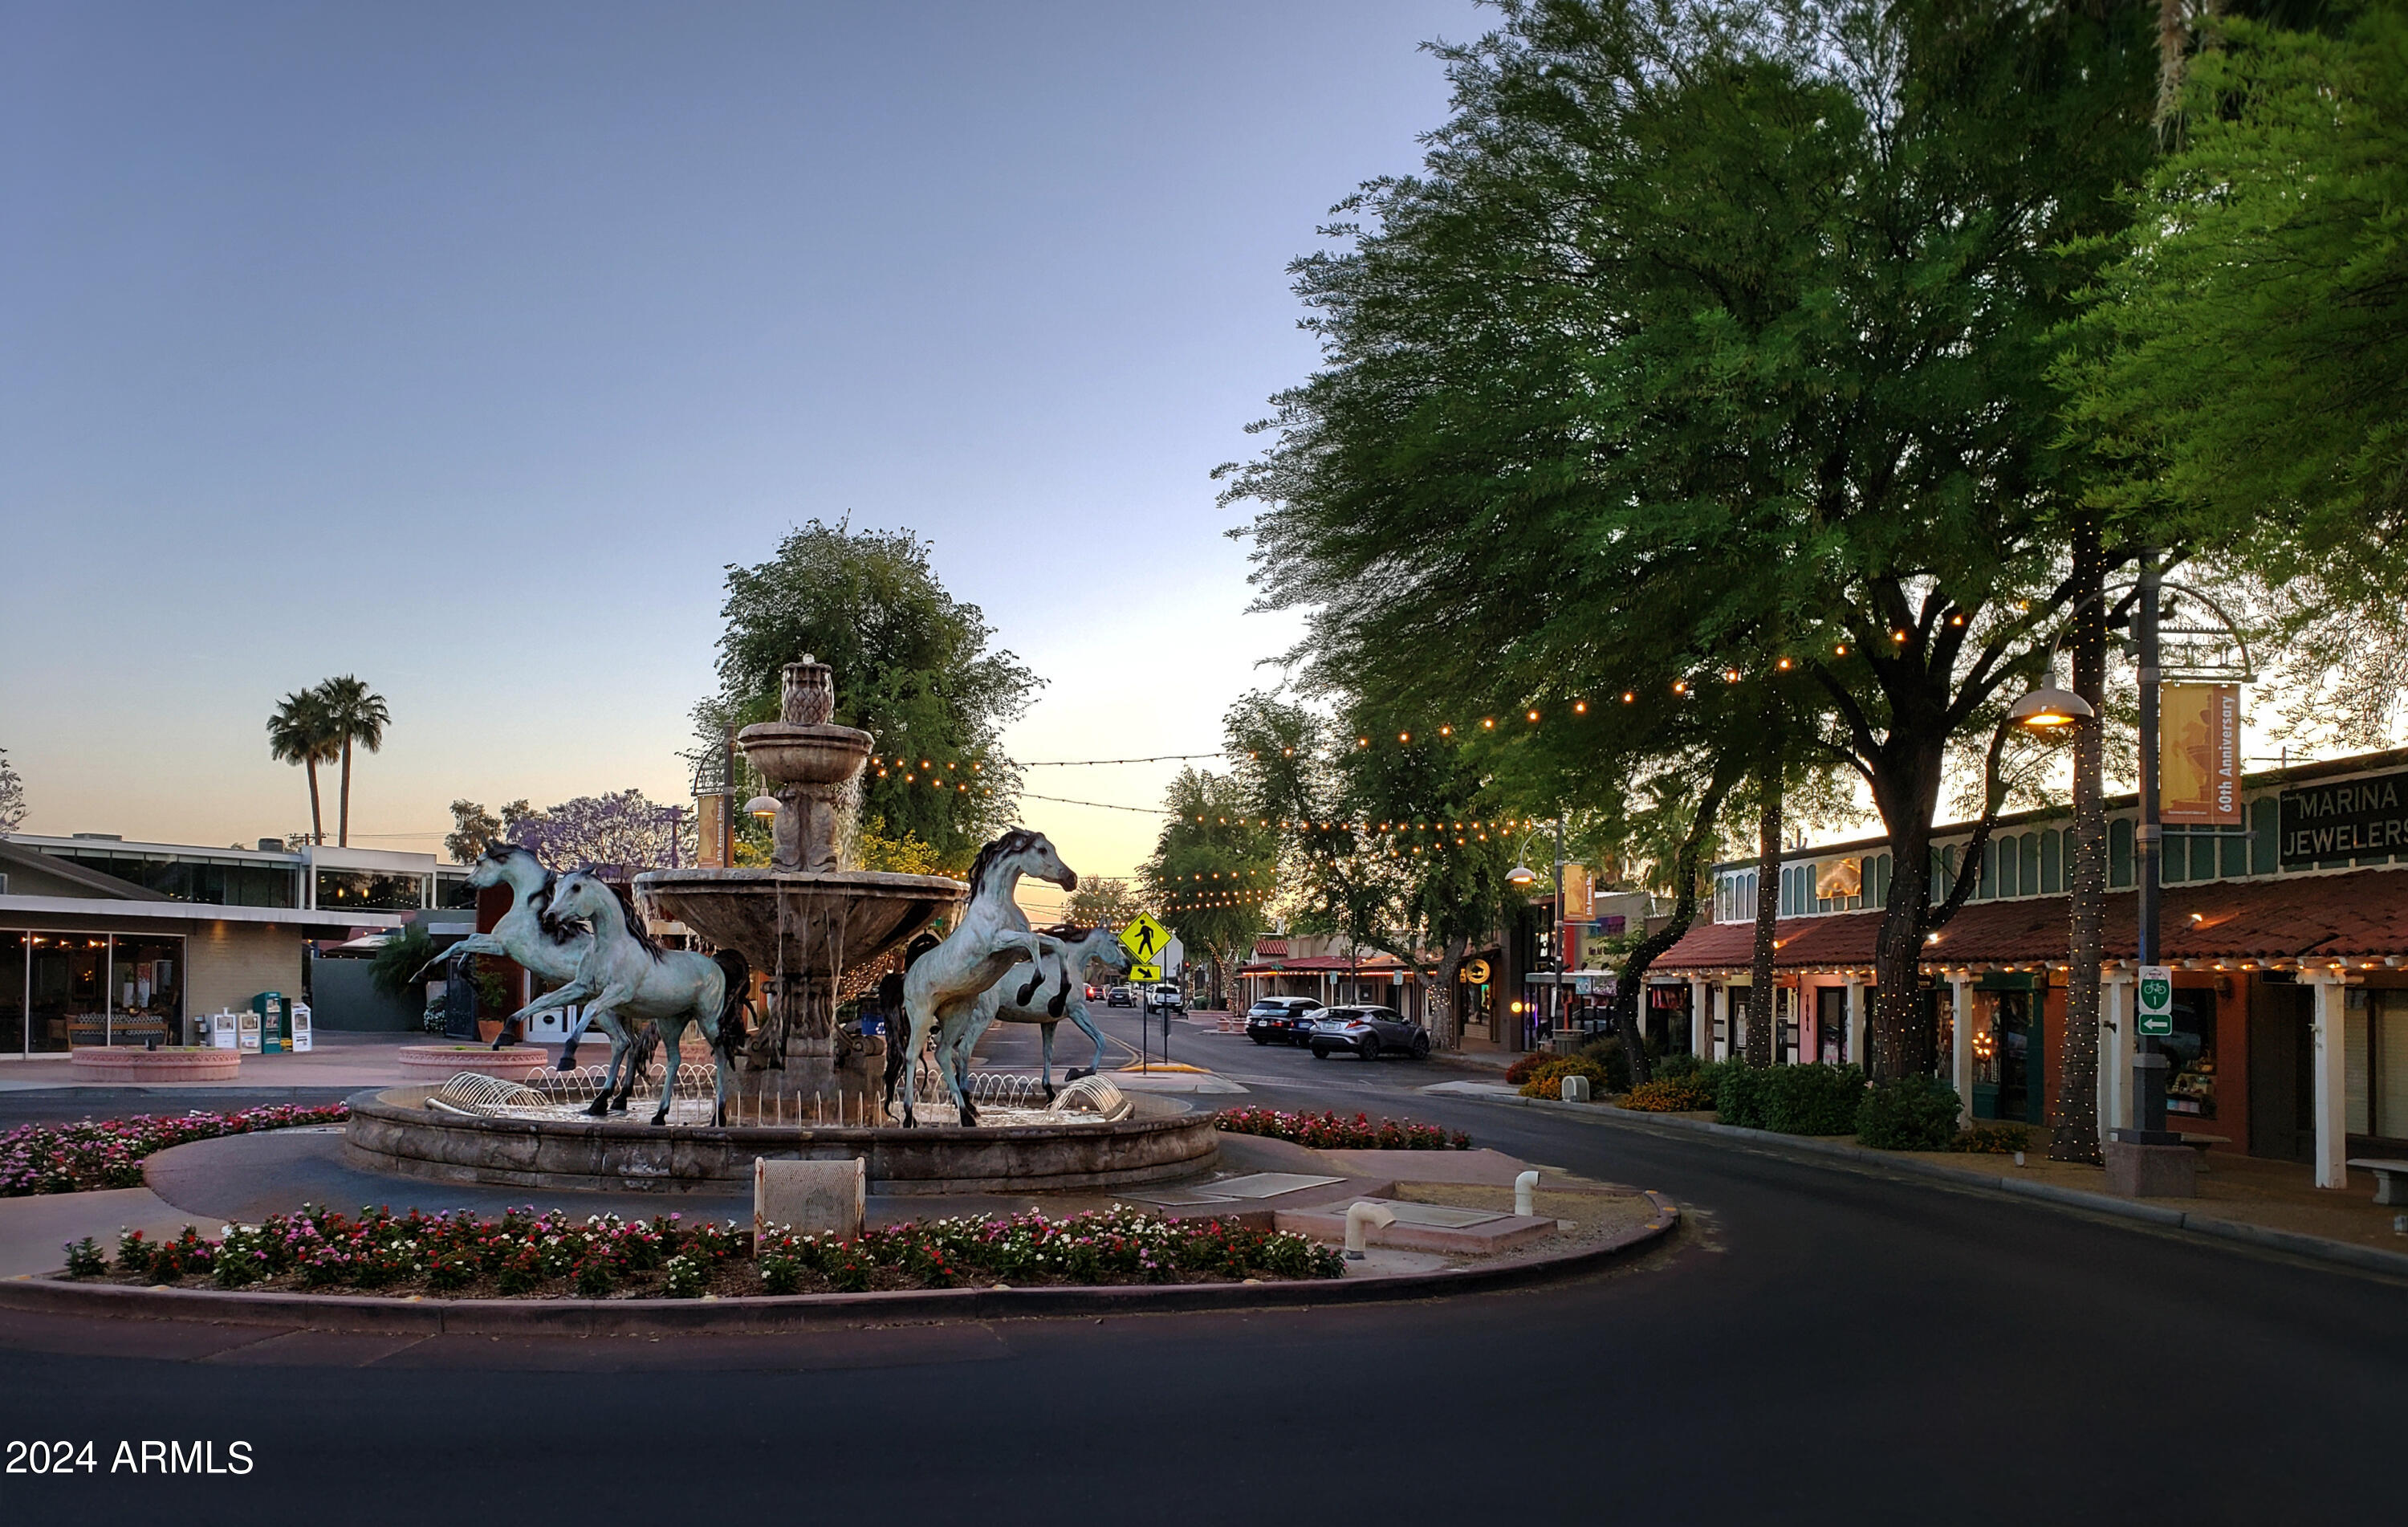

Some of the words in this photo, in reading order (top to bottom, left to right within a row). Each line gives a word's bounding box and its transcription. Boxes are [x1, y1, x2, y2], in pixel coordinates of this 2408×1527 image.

[2218, 696, 2235, 777] Anniversary
[2218, 781, 2232, 813] 60th
[2299, 782, 2398, 820] MARINA
